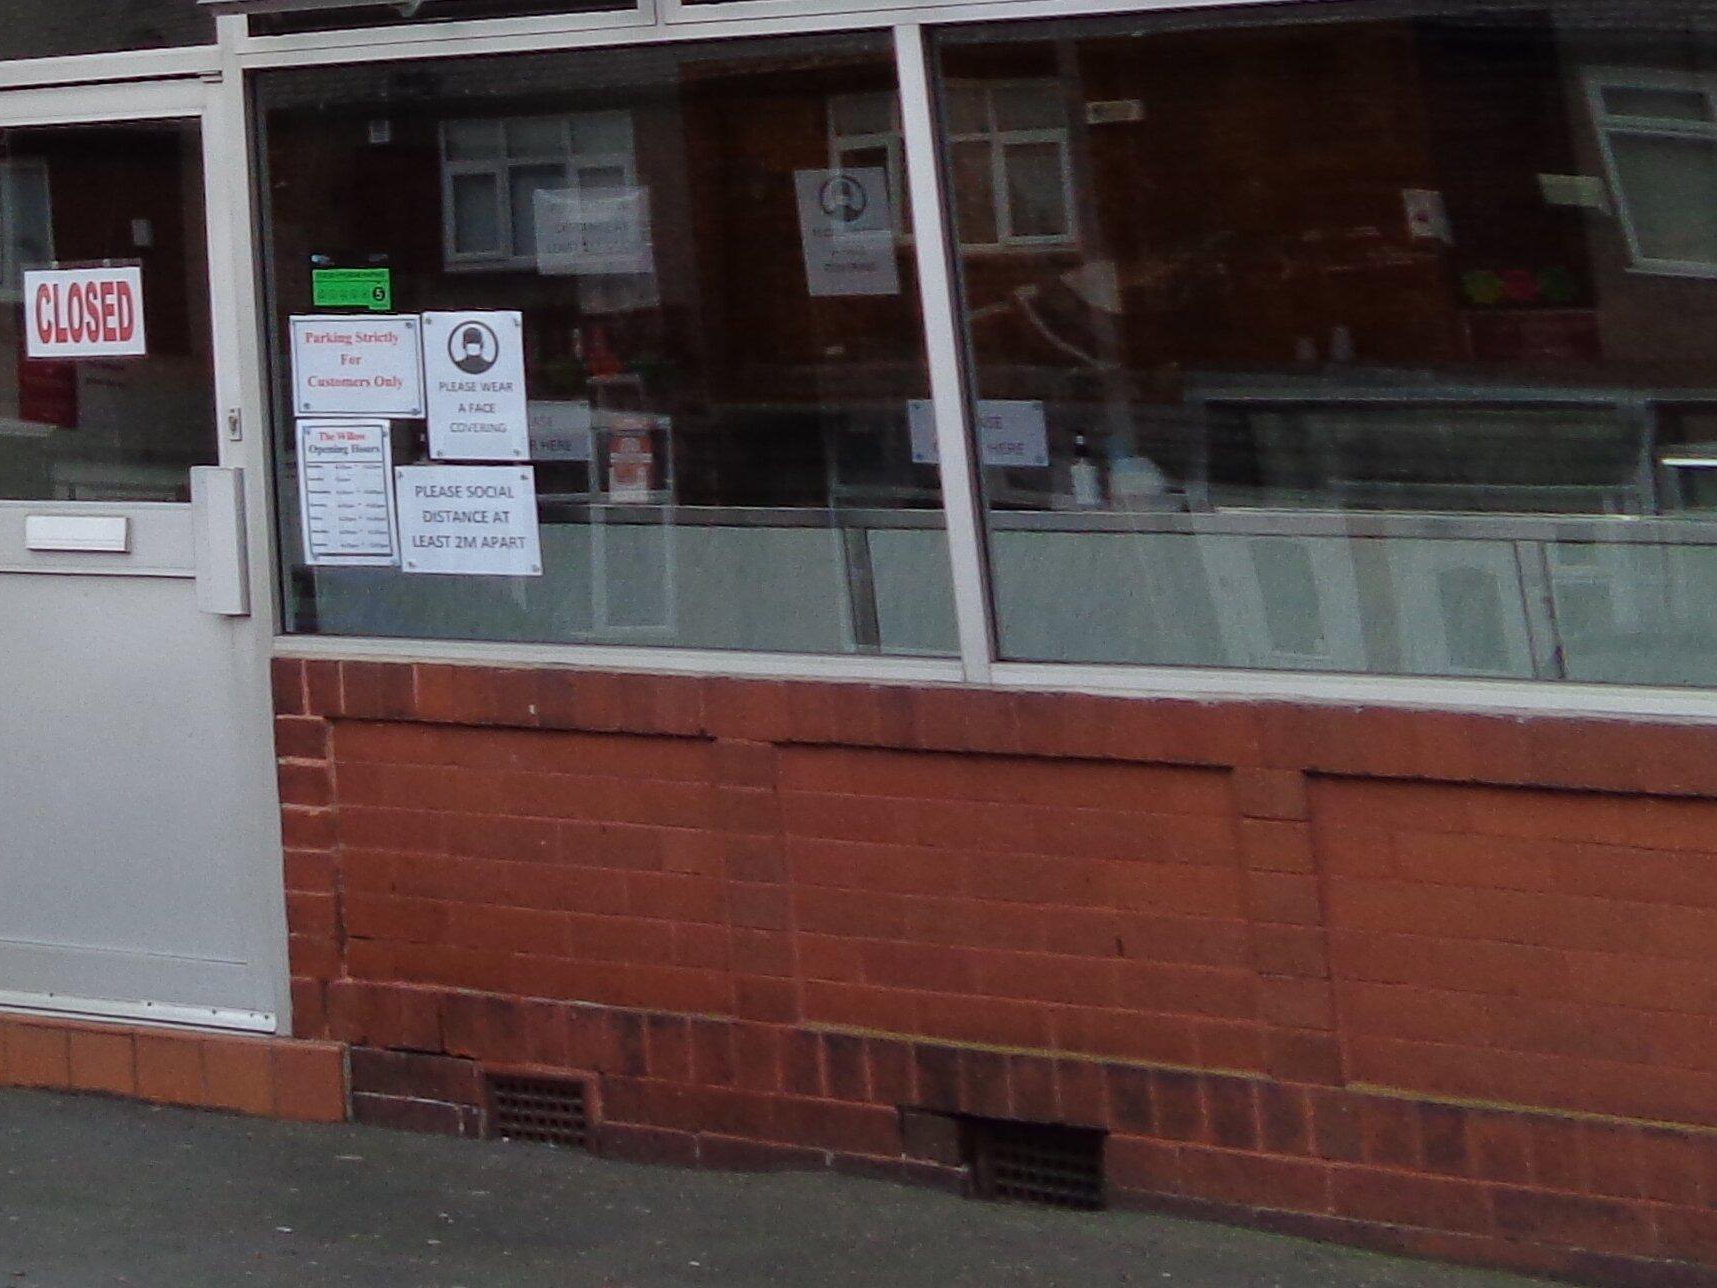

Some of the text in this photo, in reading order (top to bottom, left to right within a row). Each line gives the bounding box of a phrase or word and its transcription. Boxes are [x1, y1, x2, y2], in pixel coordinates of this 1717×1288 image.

[35, 280, 134, 344] CLOSED
[305, 331, 399, 346] Parking Strictly
[340, 353, 363, 365] For
[307, 375, 403, 389] Customers Only
[438, 381, 514, 392] PLEASE WEAR
[458, 402, 497, 414] A FACE
[448, 422, 508, 434] COVERING
[308, 444, 350, 456] Opening
[414, 485, 516, 499] PLEASE SOCIAL
[421, 510, 510, 524] DISTANCE AT
[411, 534, 527, 550] LEAST 2M APART
